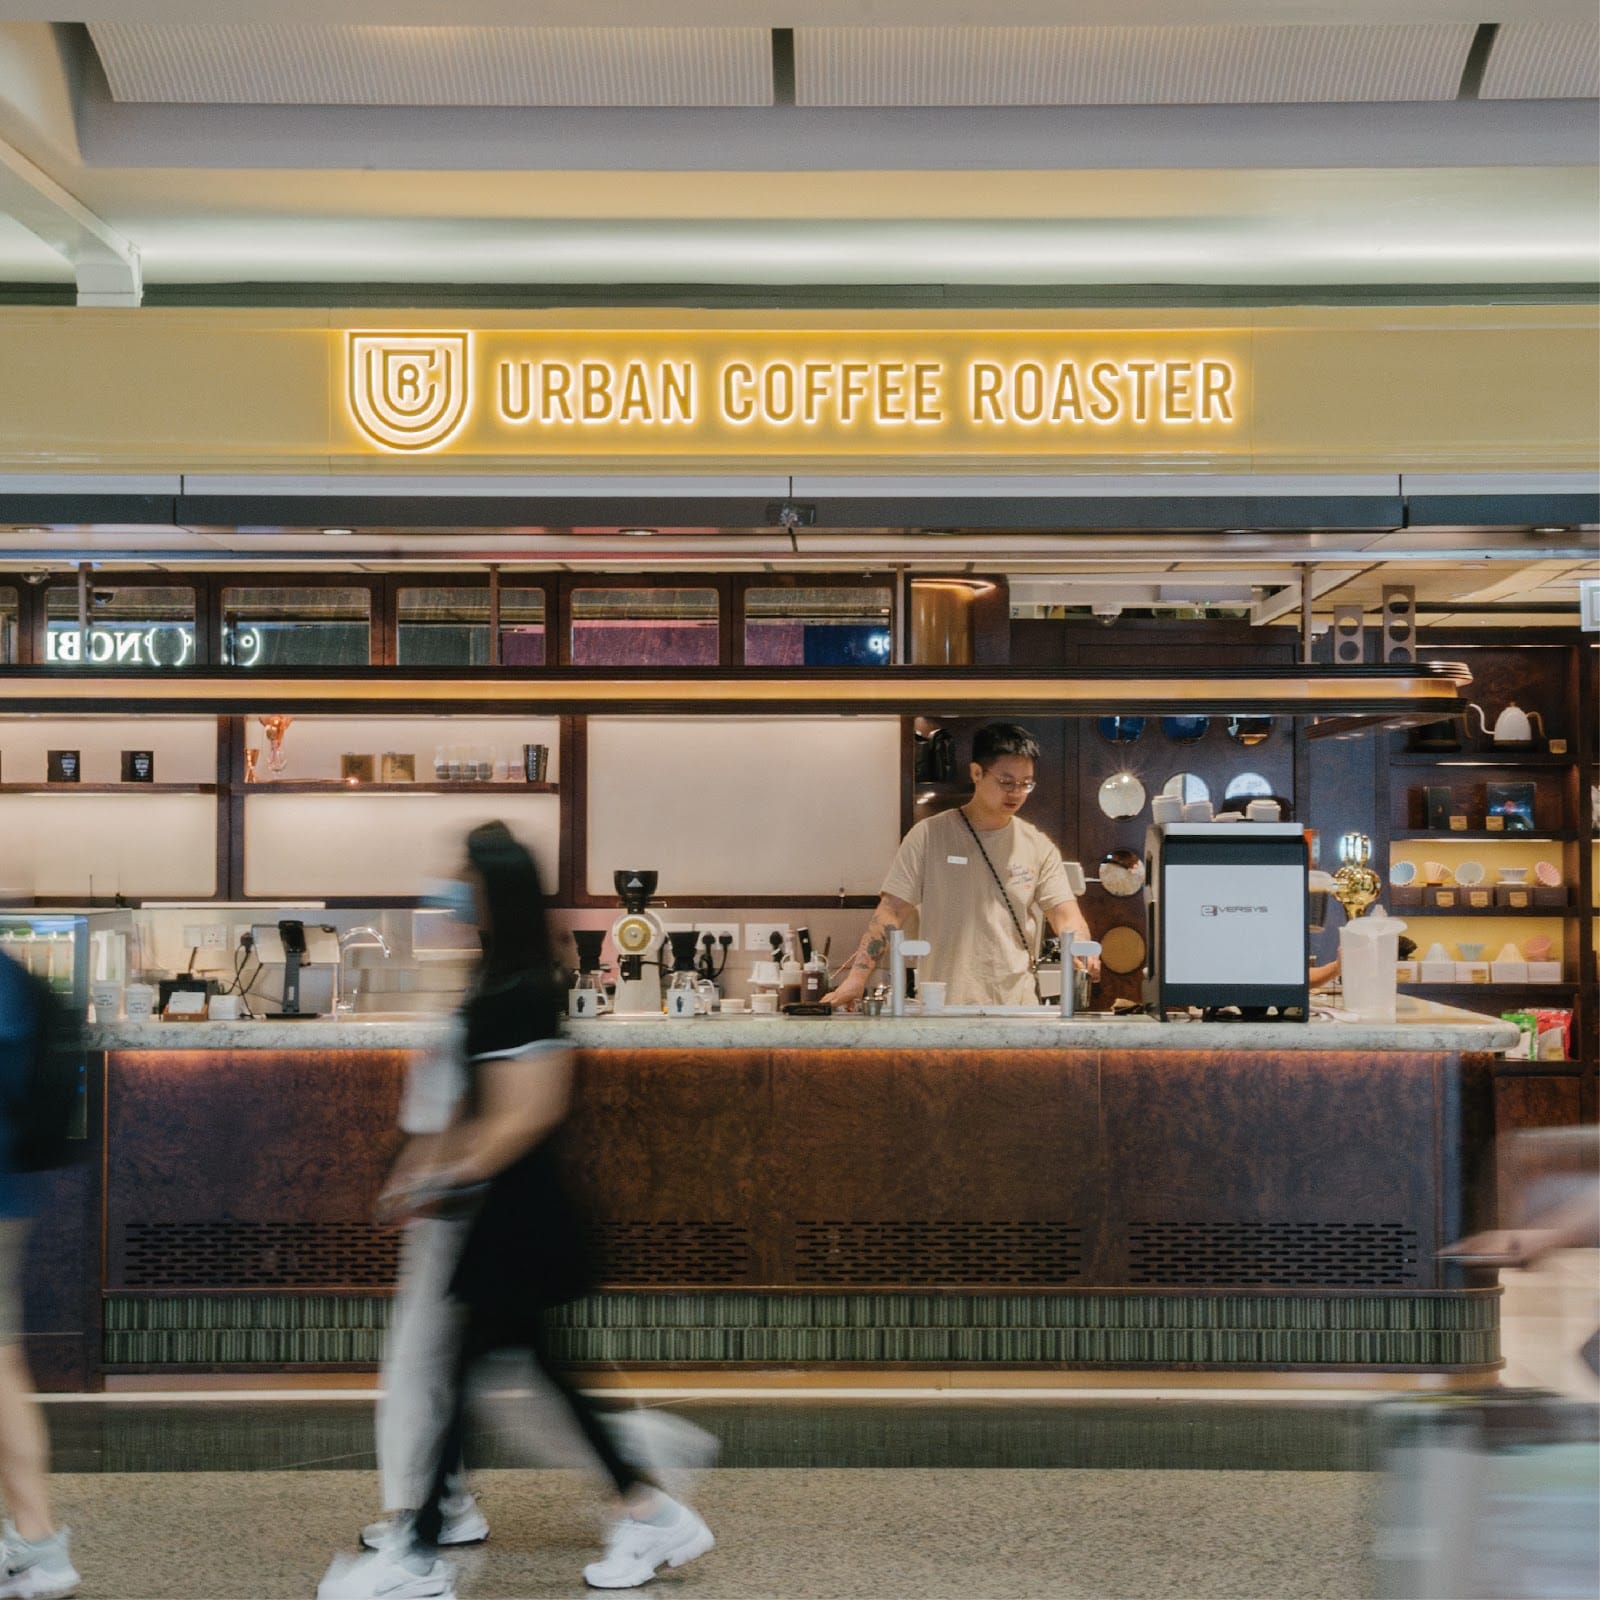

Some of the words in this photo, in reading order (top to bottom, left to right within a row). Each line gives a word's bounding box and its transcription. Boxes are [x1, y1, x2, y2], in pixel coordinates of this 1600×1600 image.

[500, 363, 692, 420] URBAN
[724, 363, 942, 421] COFFEE
[973, 362, 1233, 421] ROASTER
